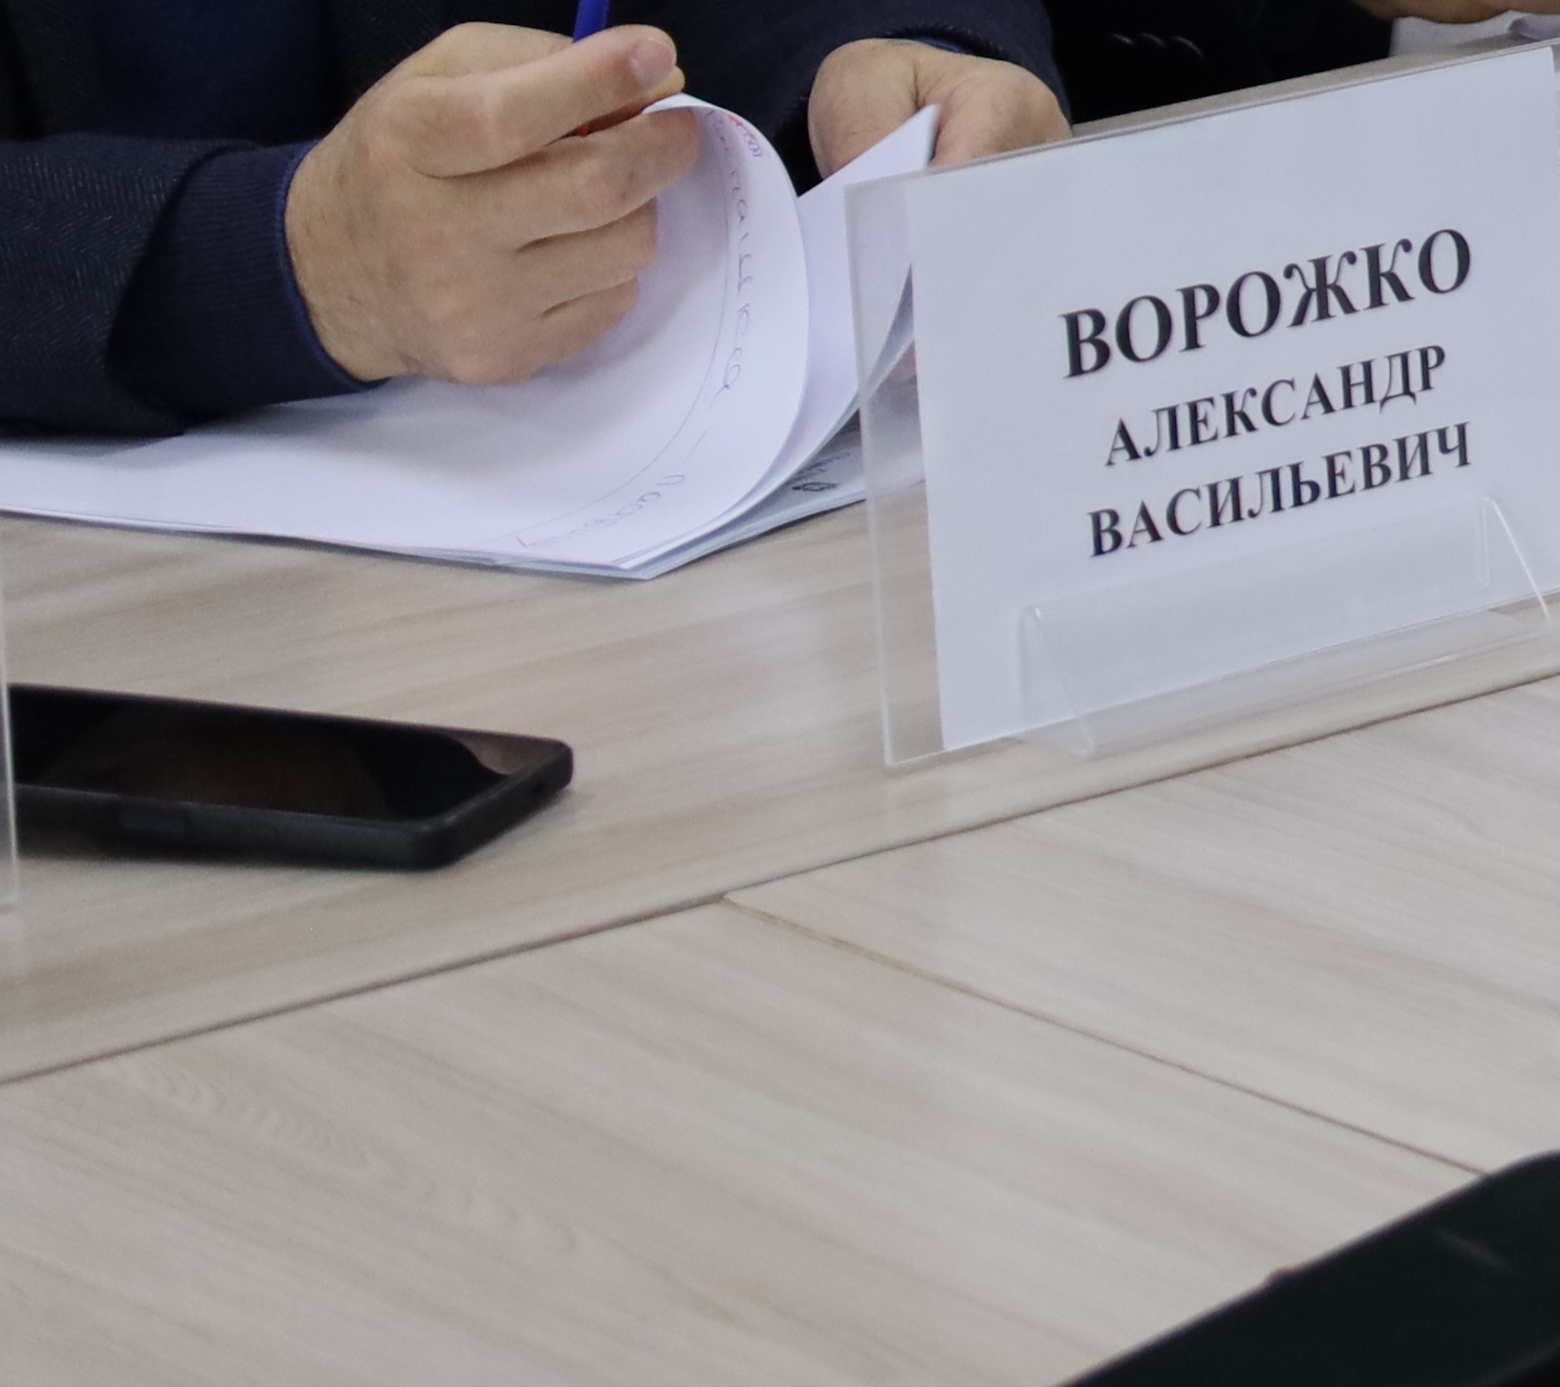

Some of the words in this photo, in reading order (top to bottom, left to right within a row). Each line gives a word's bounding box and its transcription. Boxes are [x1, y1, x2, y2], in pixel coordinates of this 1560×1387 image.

[1062, 227, 1472, 377] ВОРОЖКО
[1107, 347, 1445, 462] АЛЕКСАНДР
[1087, 426, 1469, 554] ВАСИЛЬЕВИЧ
